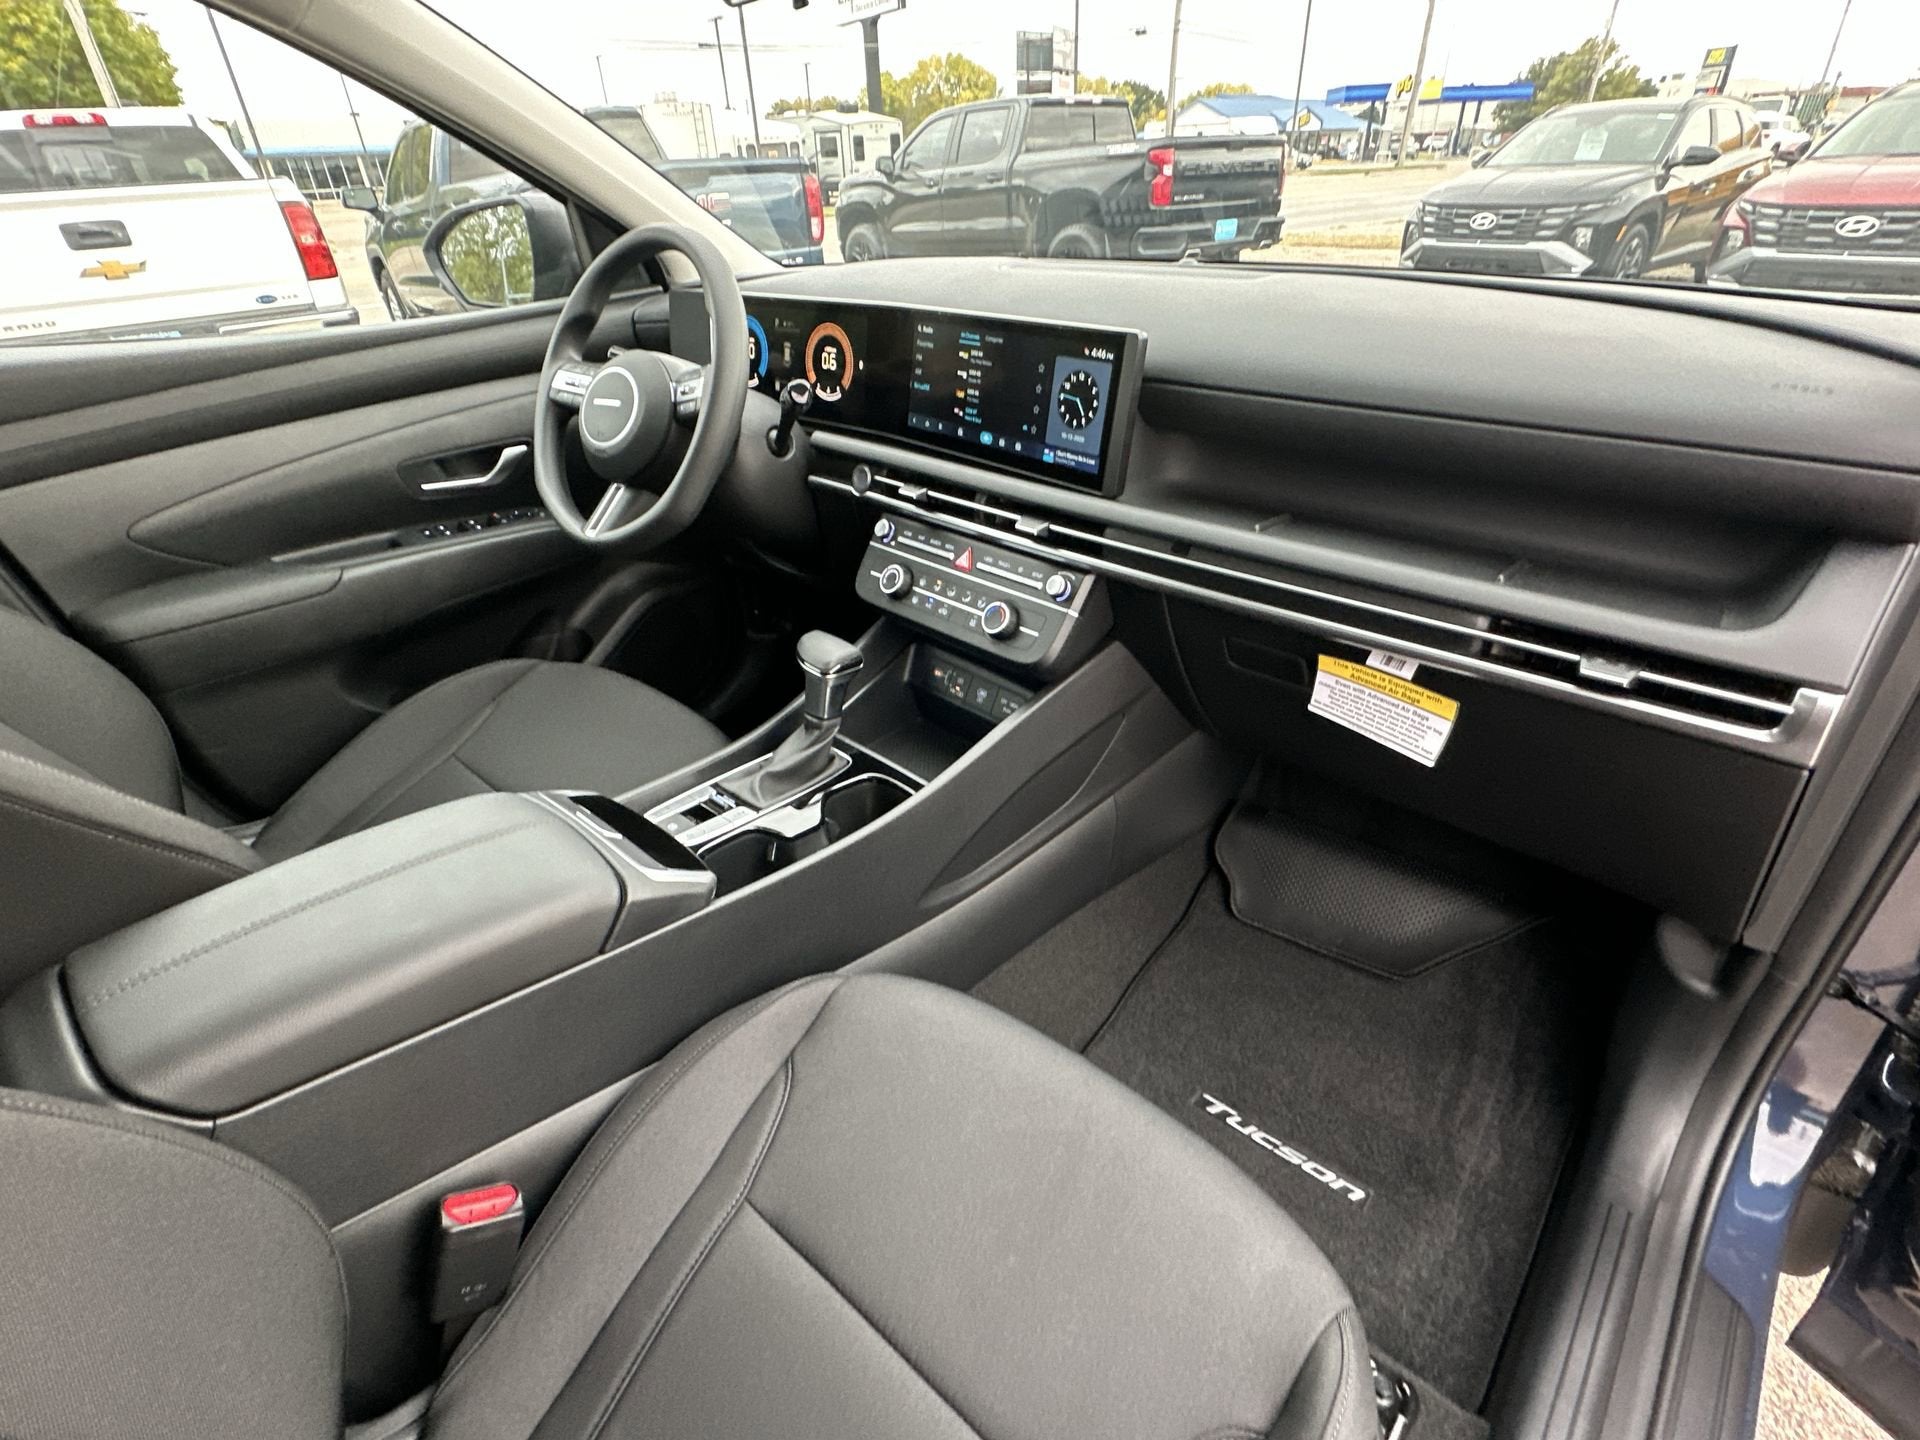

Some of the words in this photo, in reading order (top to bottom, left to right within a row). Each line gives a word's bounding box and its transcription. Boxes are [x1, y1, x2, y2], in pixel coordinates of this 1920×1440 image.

[1350, 673, 1387, 691] Advanced
[1387, 686, 1400, 696] Air
[1401, 691, 1421, 705] Bags
[1351, 665, 1377, 680] Vehicle
[1387, 678, 1424, 697] Equipped
[1425, 693, 1443, 704] with
[1352, 685, 1366, 695] with
[1366, 691, 1400, 709] Advanced
[1400, 705, 1411, 714] Air
[1411, 709, 1430, 722] Bags
